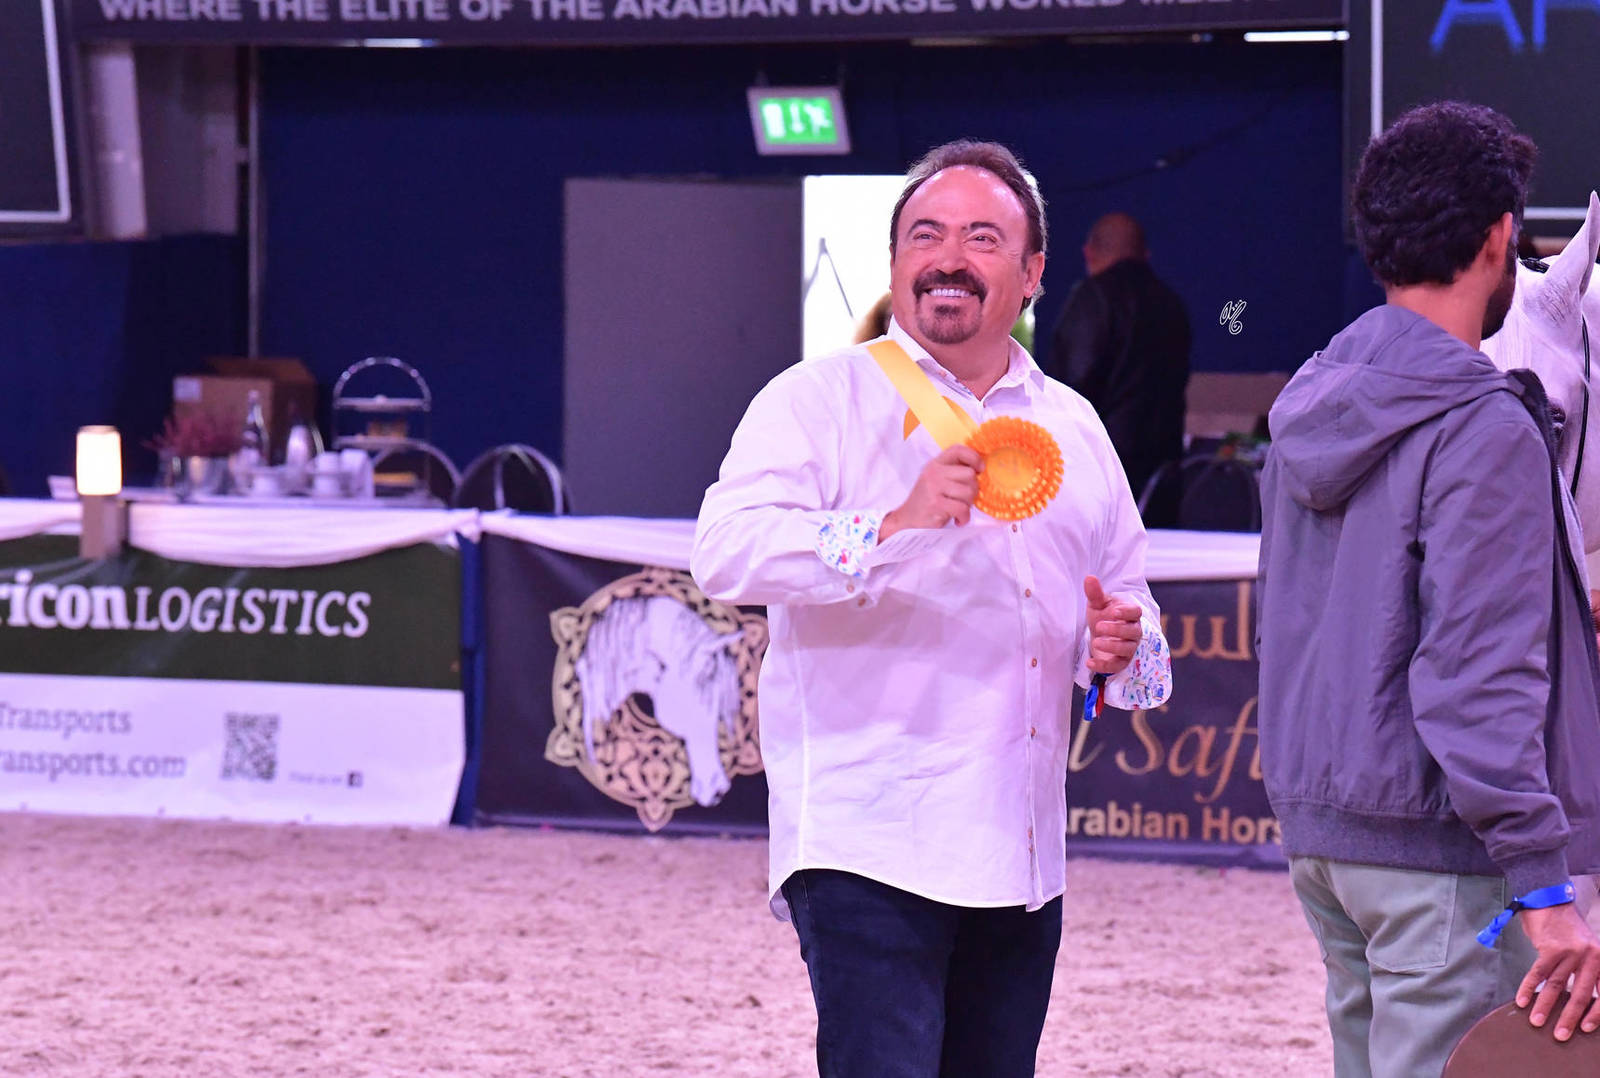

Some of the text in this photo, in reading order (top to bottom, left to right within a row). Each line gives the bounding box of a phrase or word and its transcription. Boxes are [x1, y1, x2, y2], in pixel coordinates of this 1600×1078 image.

[100, 0, 243, 21] WHERE
[258, 0, 330, 21] THE
[340, 0, 450, 21] ELITE
[459, 0, 512, 21] OF
[530, 0, 605, 20] THE
[613, 0, 799, 19] ARABIAN
[0, 749, 187, 782] ansports.com
[1114, 696, 1263, 803] Saf
[1066, 801, 1189, 839] rabian
